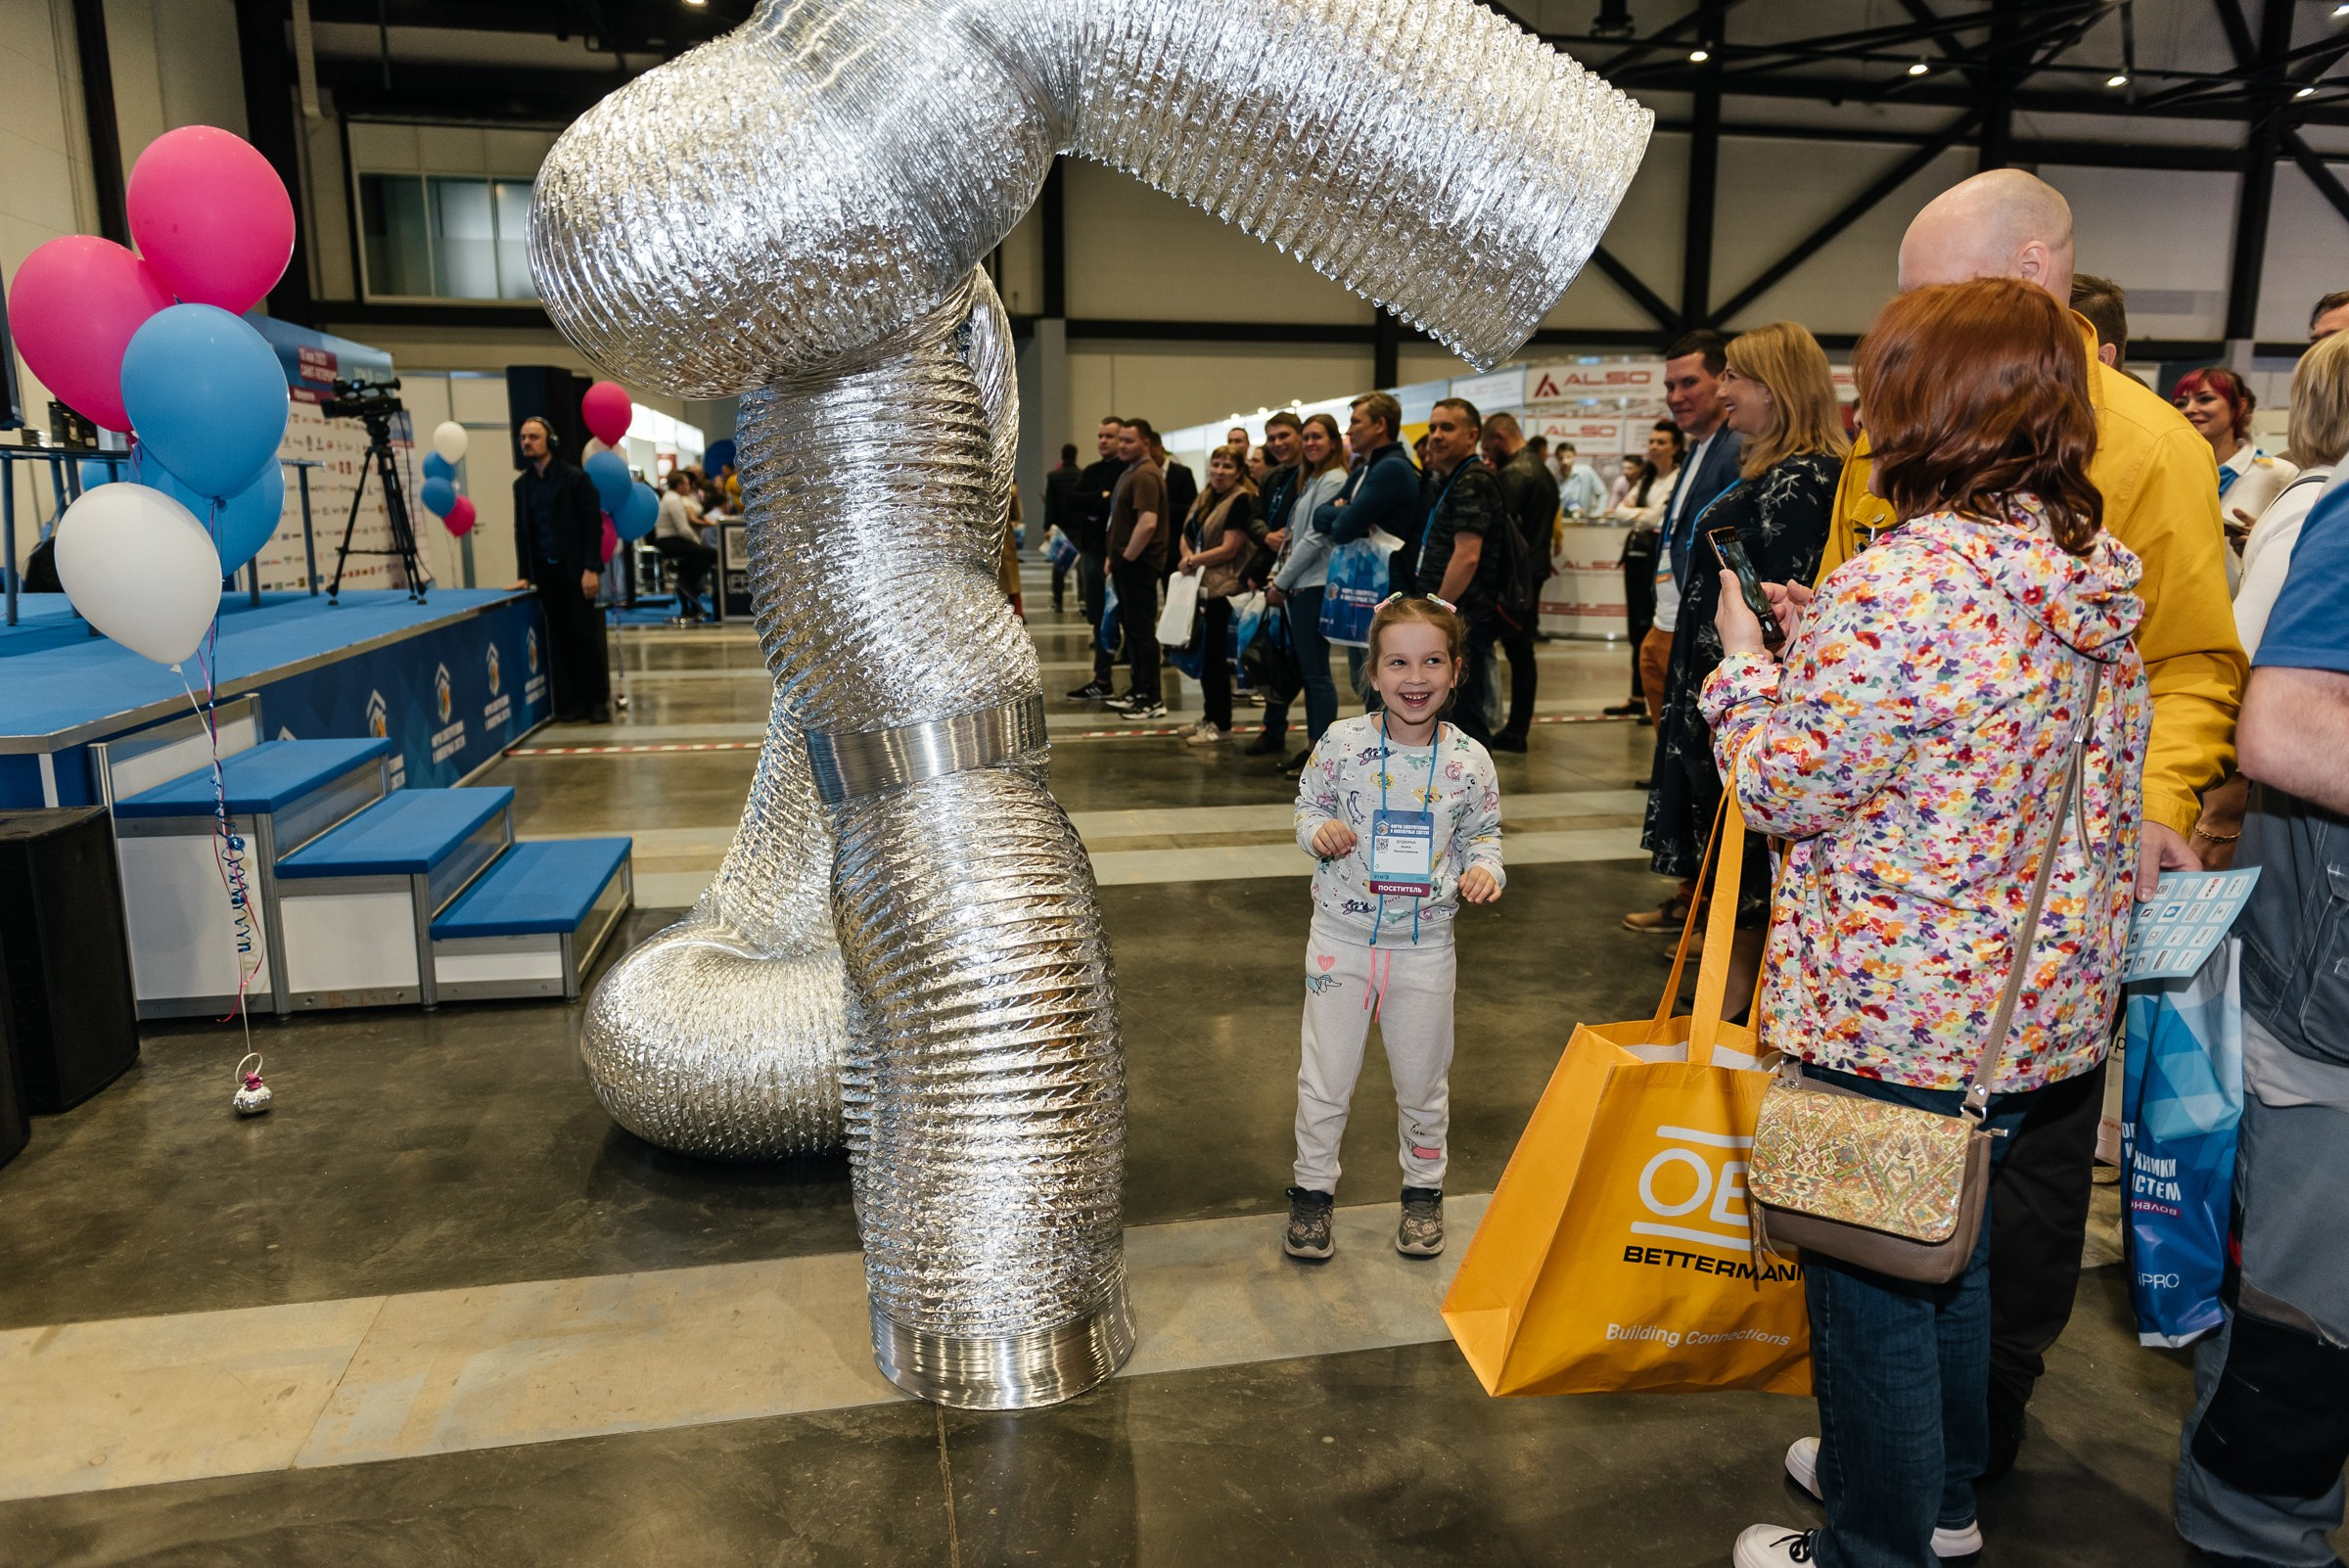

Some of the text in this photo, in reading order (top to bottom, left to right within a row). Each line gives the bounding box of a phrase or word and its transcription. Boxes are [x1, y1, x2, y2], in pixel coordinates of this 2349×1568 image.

[1564, 371, 1651, 386] ALSO
[1544, 425, 1617, 438] ALSO
[2134, 1150, 2177, 1178] ХНИКИ
[2138, 1271, 2180, 1289] iPRO
[1605, 1322, 1791, 1348] Building Connections
